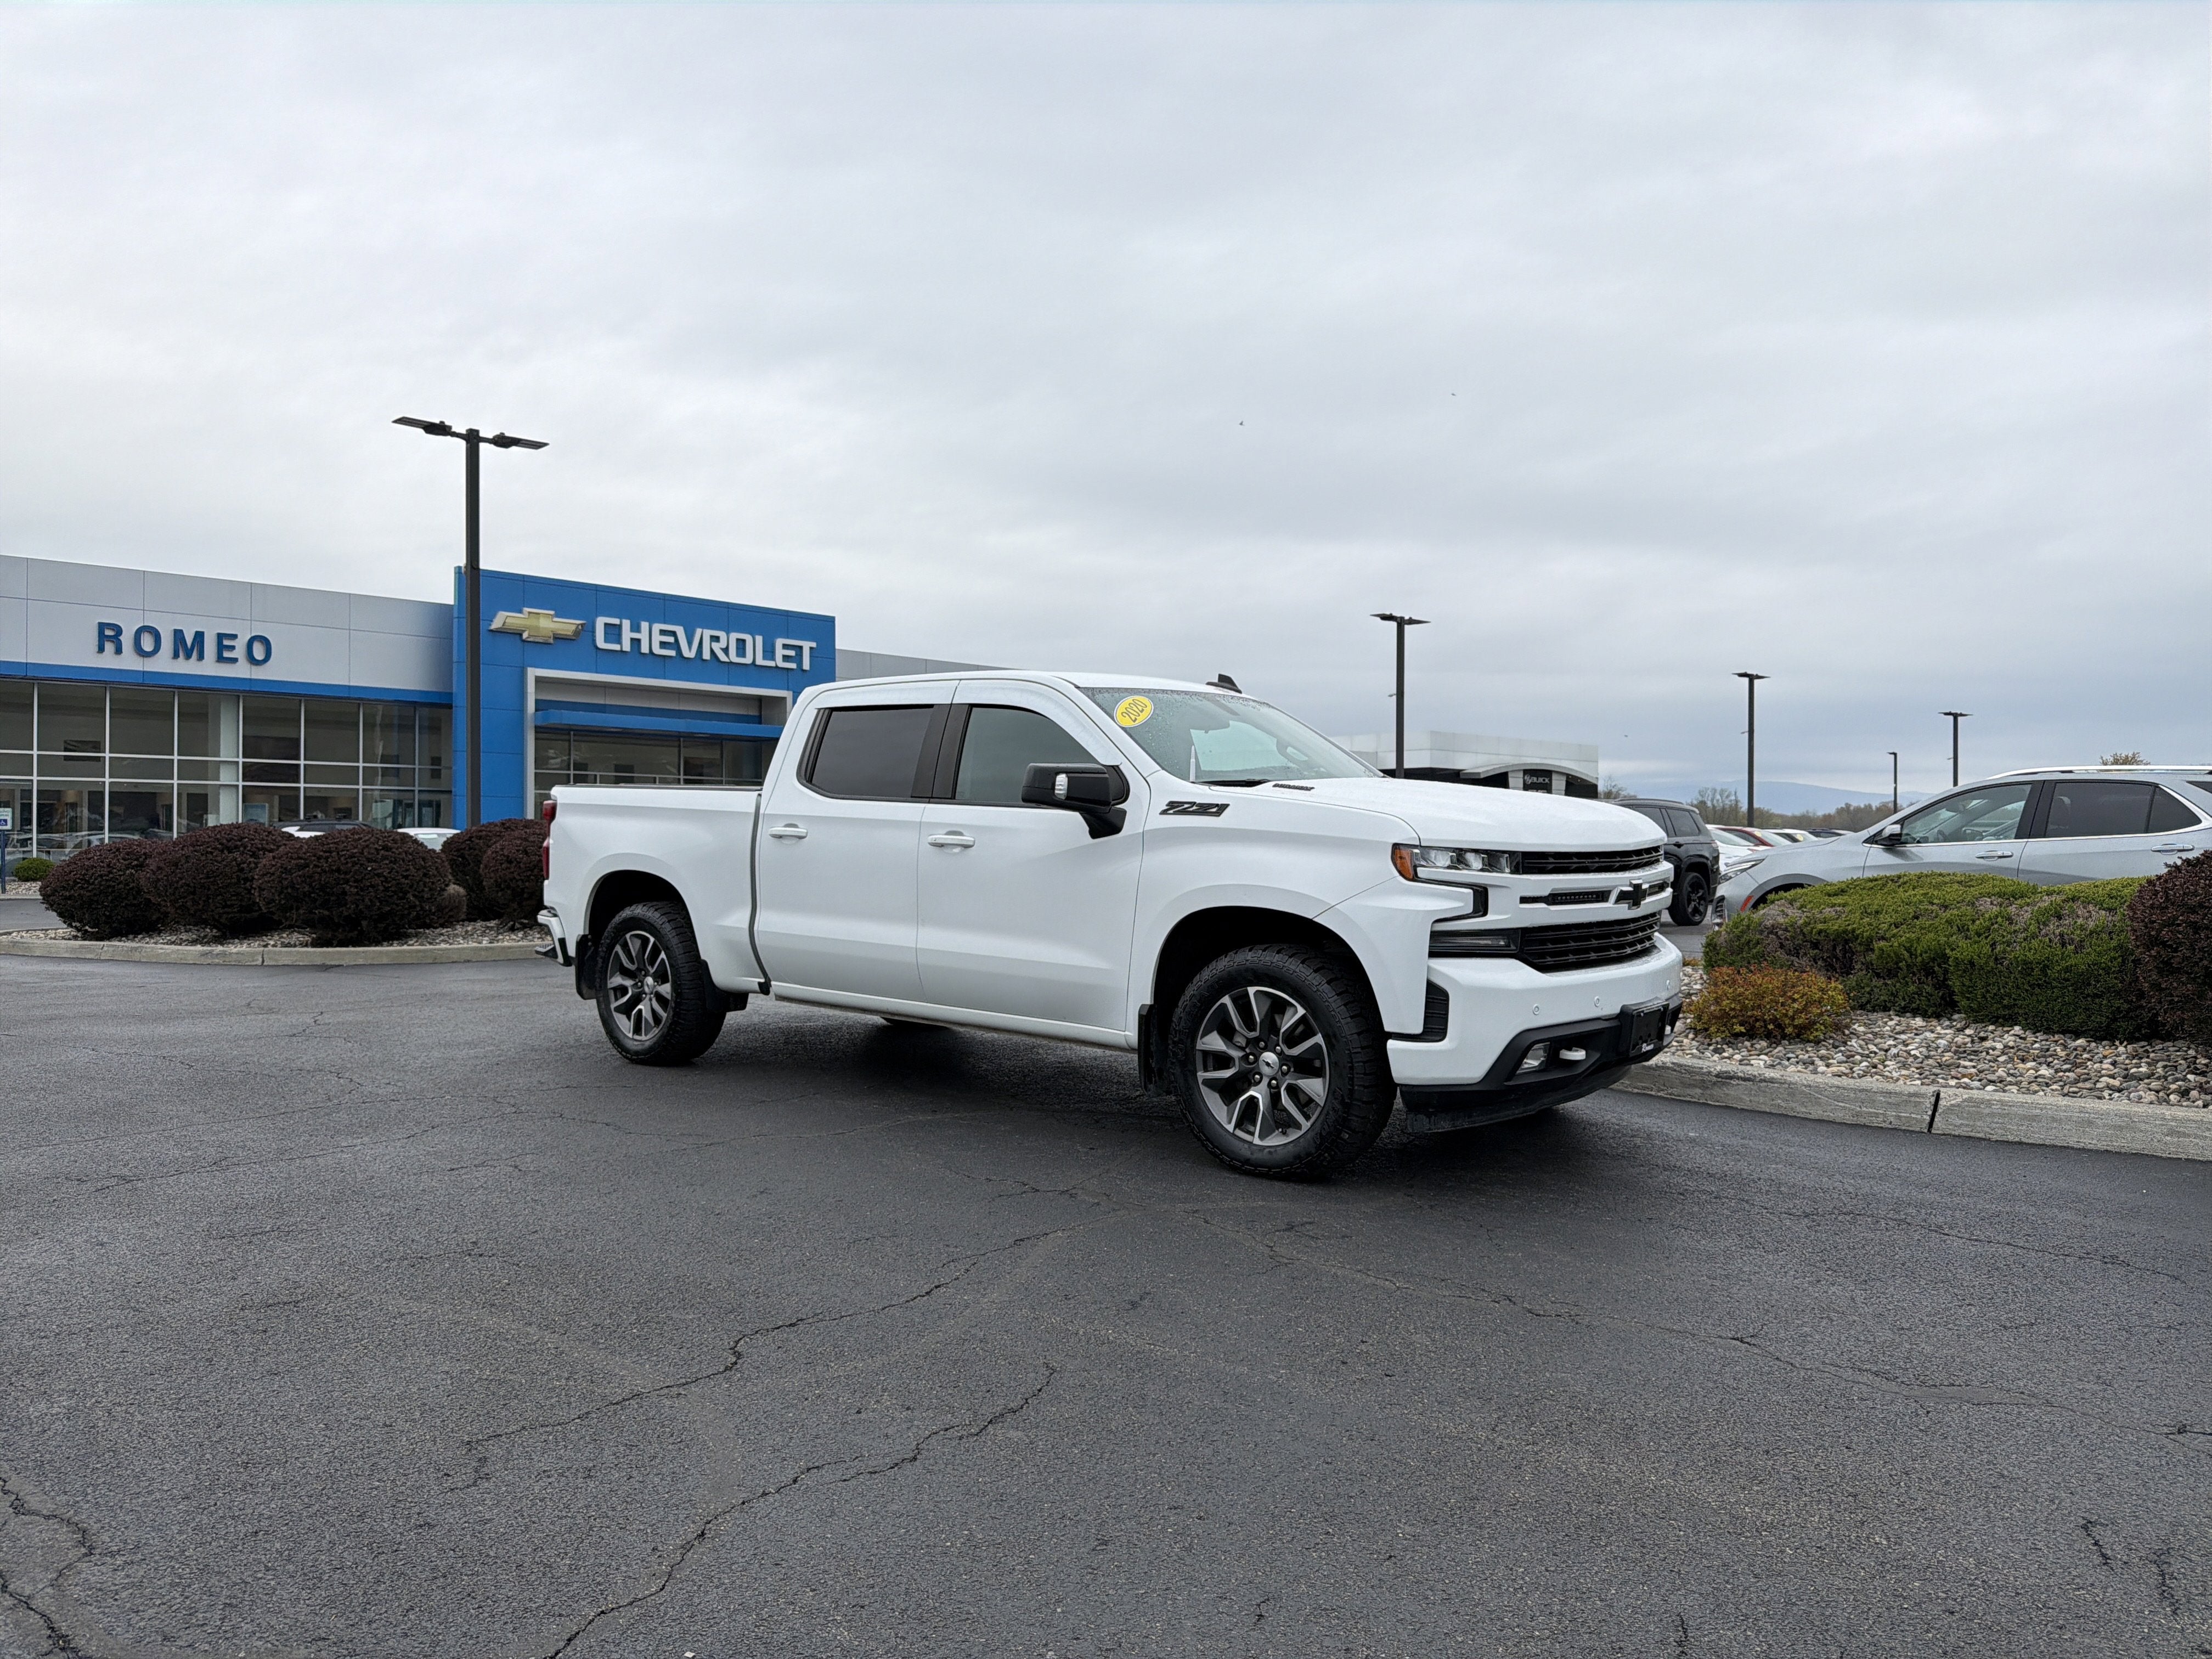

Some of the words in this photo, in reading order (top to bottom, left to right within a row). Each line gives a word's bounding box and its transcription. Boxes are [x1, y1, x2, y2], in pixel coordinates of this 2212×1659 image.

[97, 622, 273, 666] ROMEO
[595, 616, 817, 671] CHEVROLET
[1121, 698, 1148, 723] 2020
[1159, 800, 1231, 817] Z71
